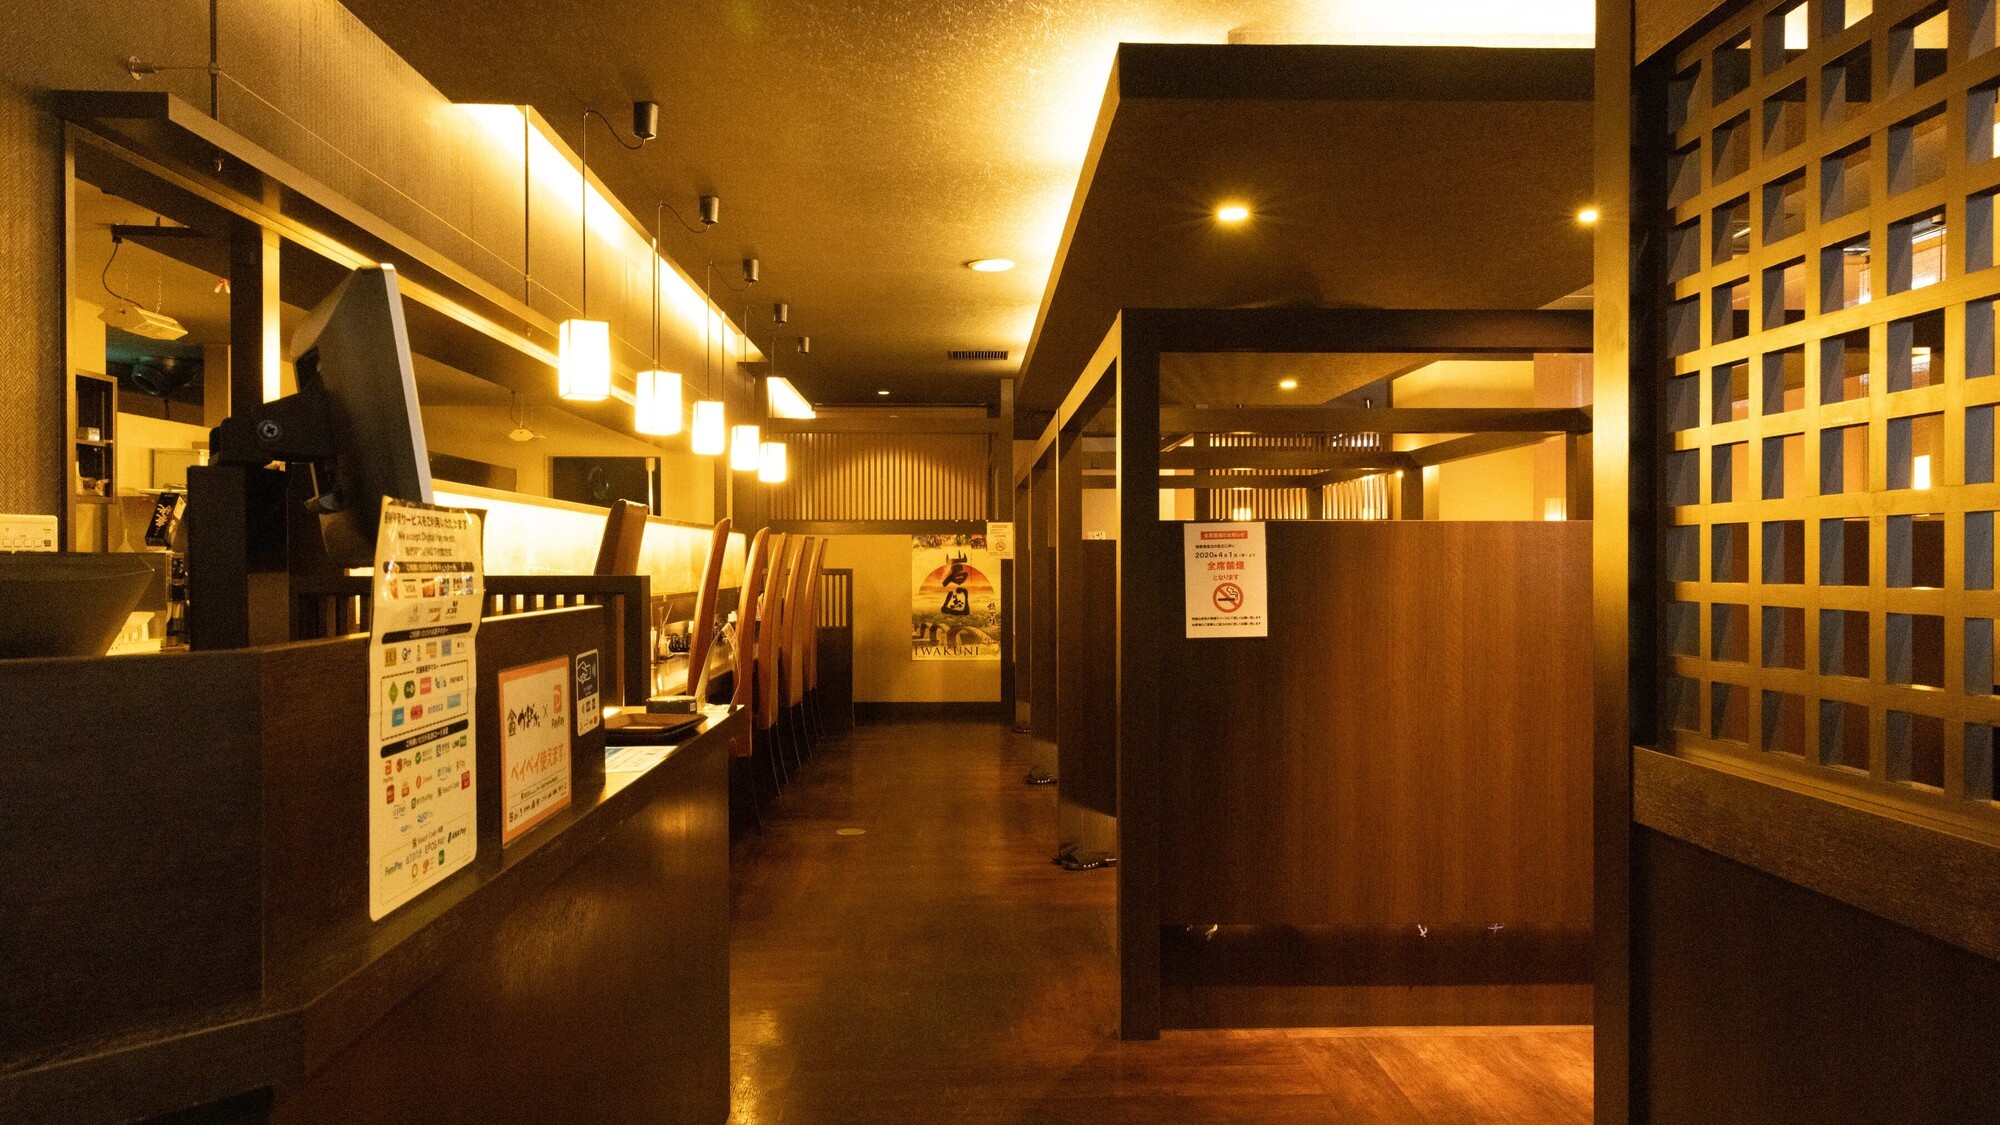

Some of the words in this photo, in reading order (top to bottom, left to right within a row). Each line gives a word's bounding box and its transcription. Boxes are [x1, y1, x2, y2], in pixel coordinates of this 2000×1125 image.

[1207, 561, 1245, 571] 全席禁煙
[913, 646, 979, 656] IWAKUNI
